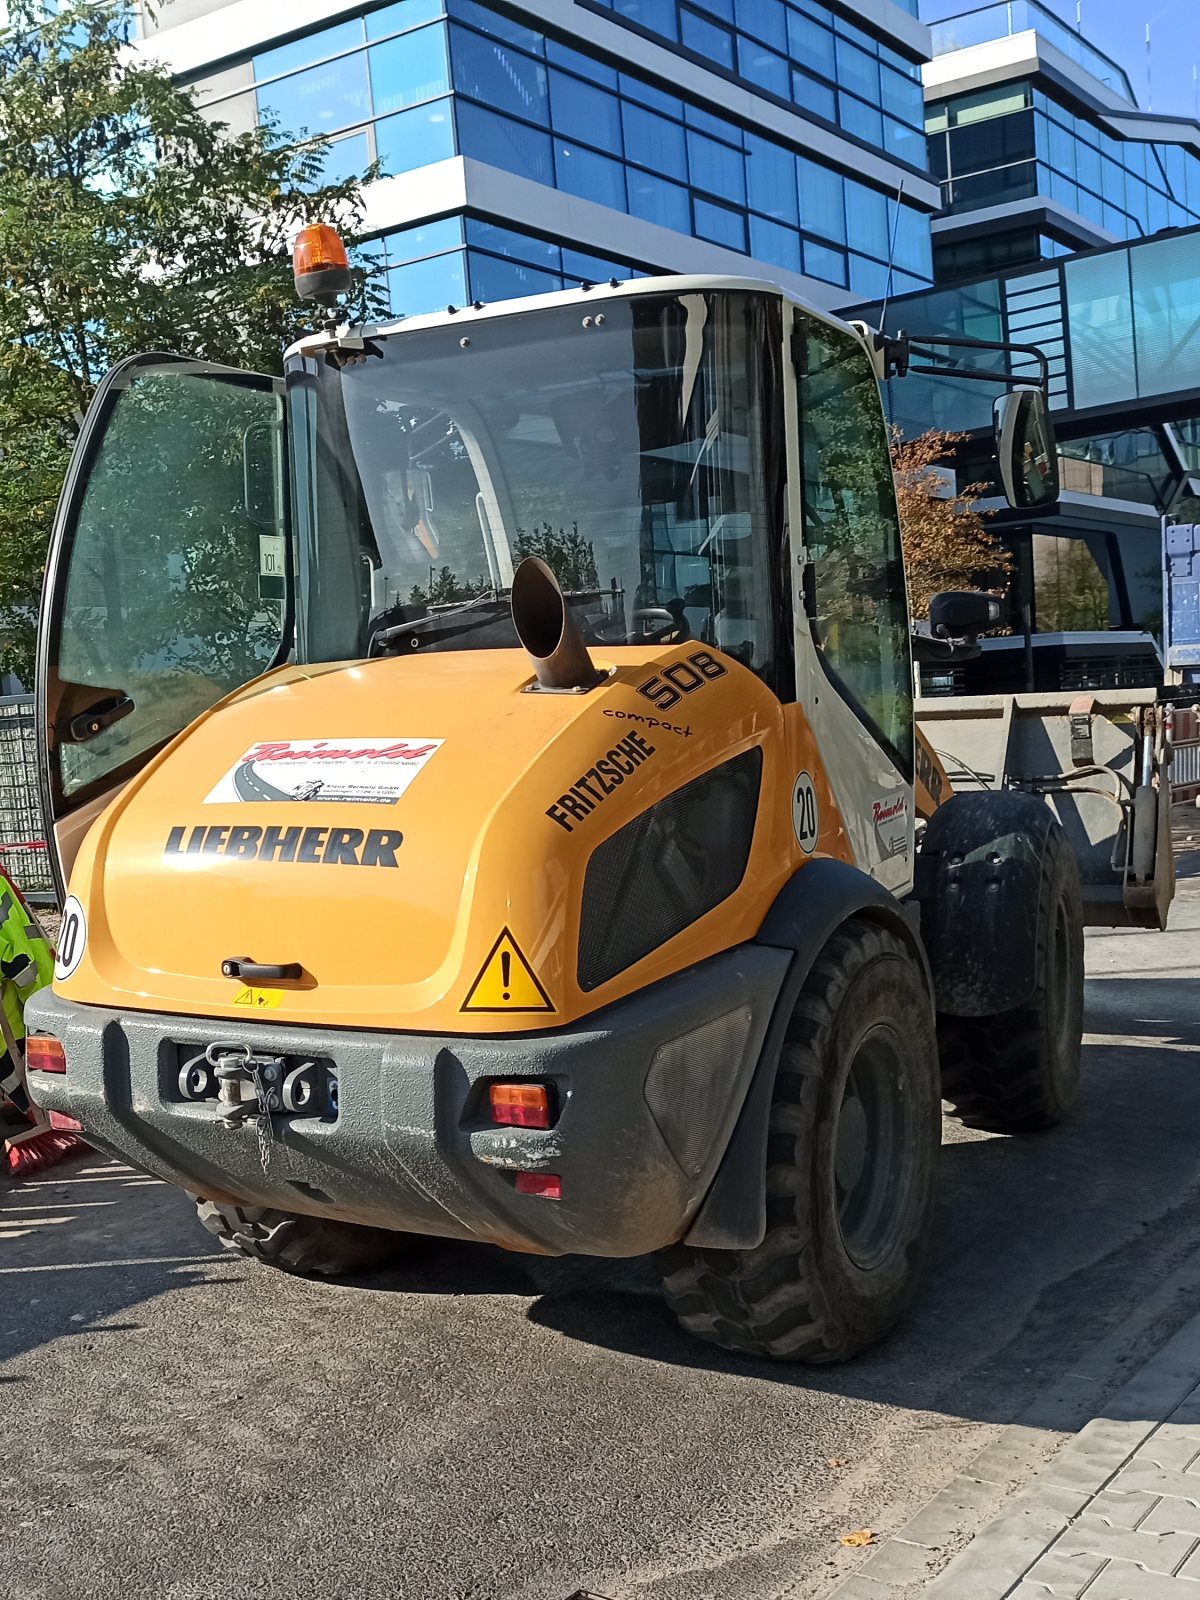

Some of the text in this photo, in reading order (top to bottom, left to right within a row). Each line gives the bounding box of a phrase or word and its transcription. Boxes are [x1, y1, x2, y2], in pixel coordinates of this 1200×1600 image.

[635, 650, 728, 711] 508
[602, 709, 693, 737] compact
[242, 742, 438, 763] Reimold
[544, 730, 656, 833] FRITZSCHE
[797, 785, 816, 841] 20
[162, 826, 404, 868] LIEBHERR
